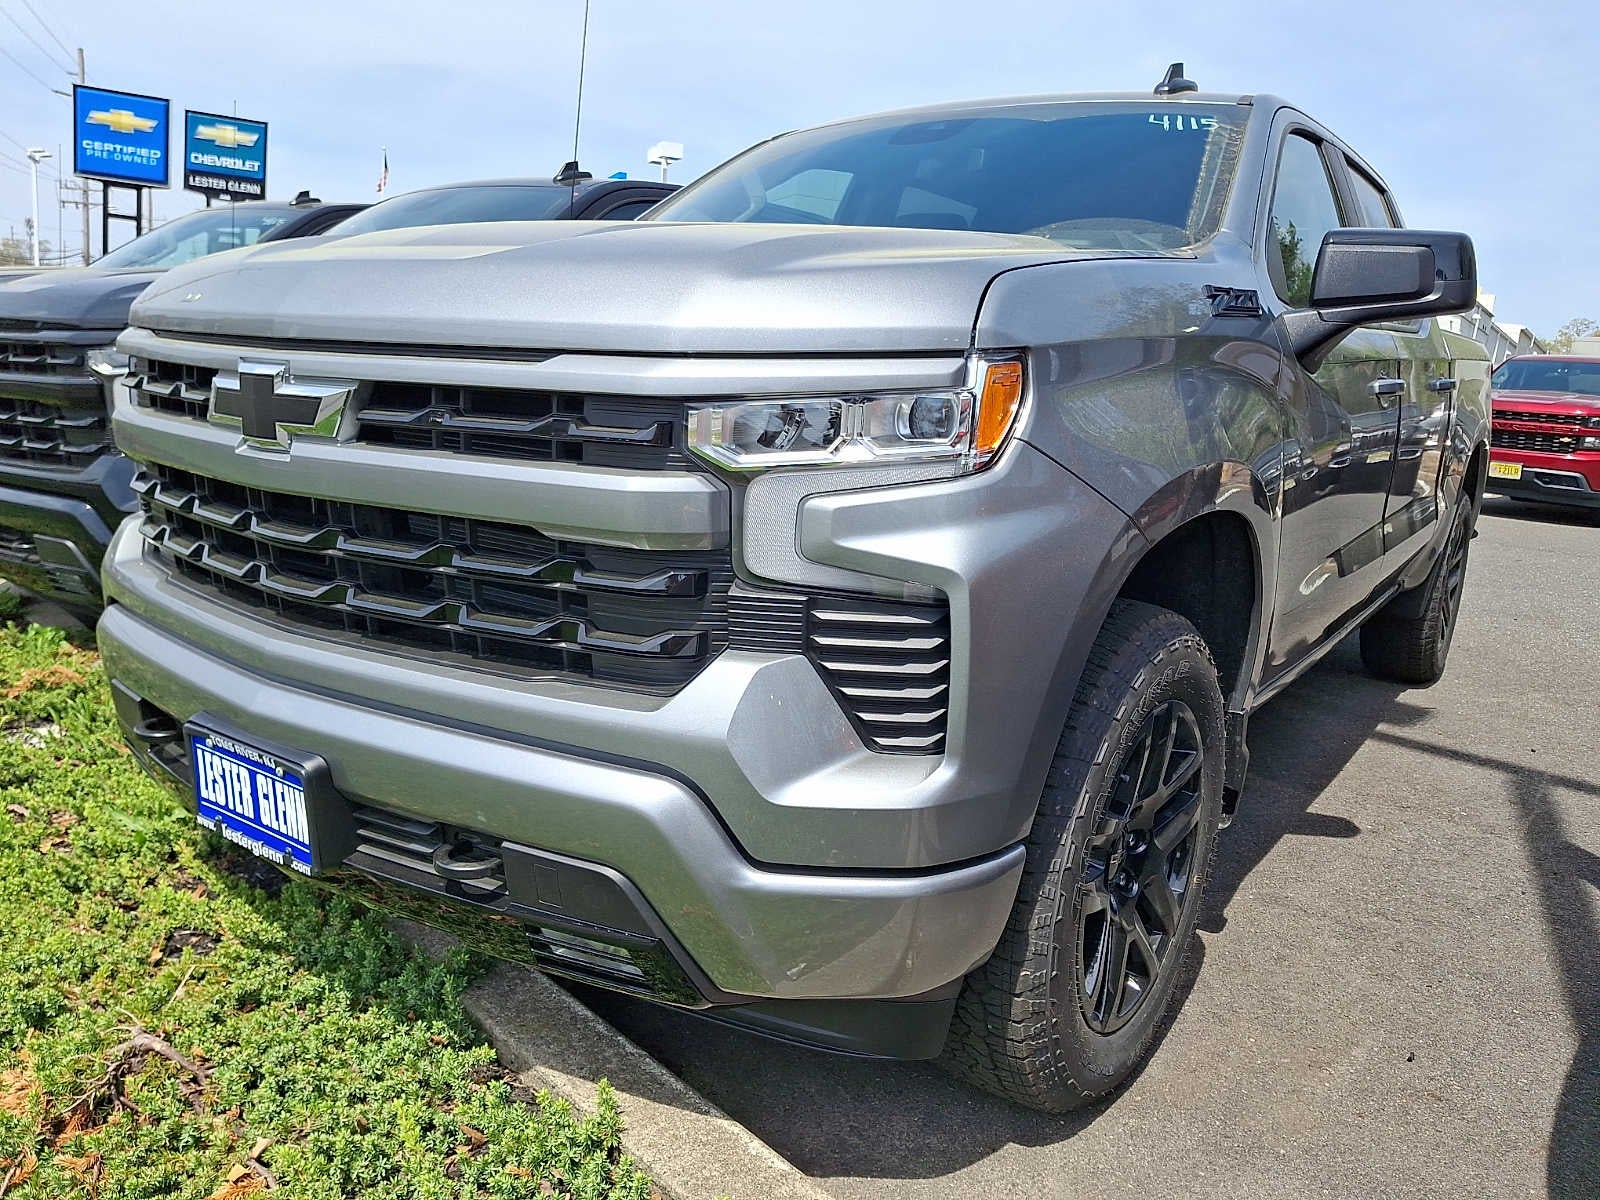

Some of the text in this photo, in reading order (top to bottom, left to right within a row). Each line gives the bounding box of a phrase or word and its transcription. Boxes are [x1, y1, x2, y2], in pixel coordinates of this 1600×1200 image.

[1149, 114, 1219, 131] 4115
[82, 139, 161, 159] CERTIFIED
[190, 152, 260, 172] CHEVROLET
[189, 175, 261, 195] LESTER GLENN
[262, 756, 276, 769] NJ
[196, 748, 310, 845] LESTER GLENN
